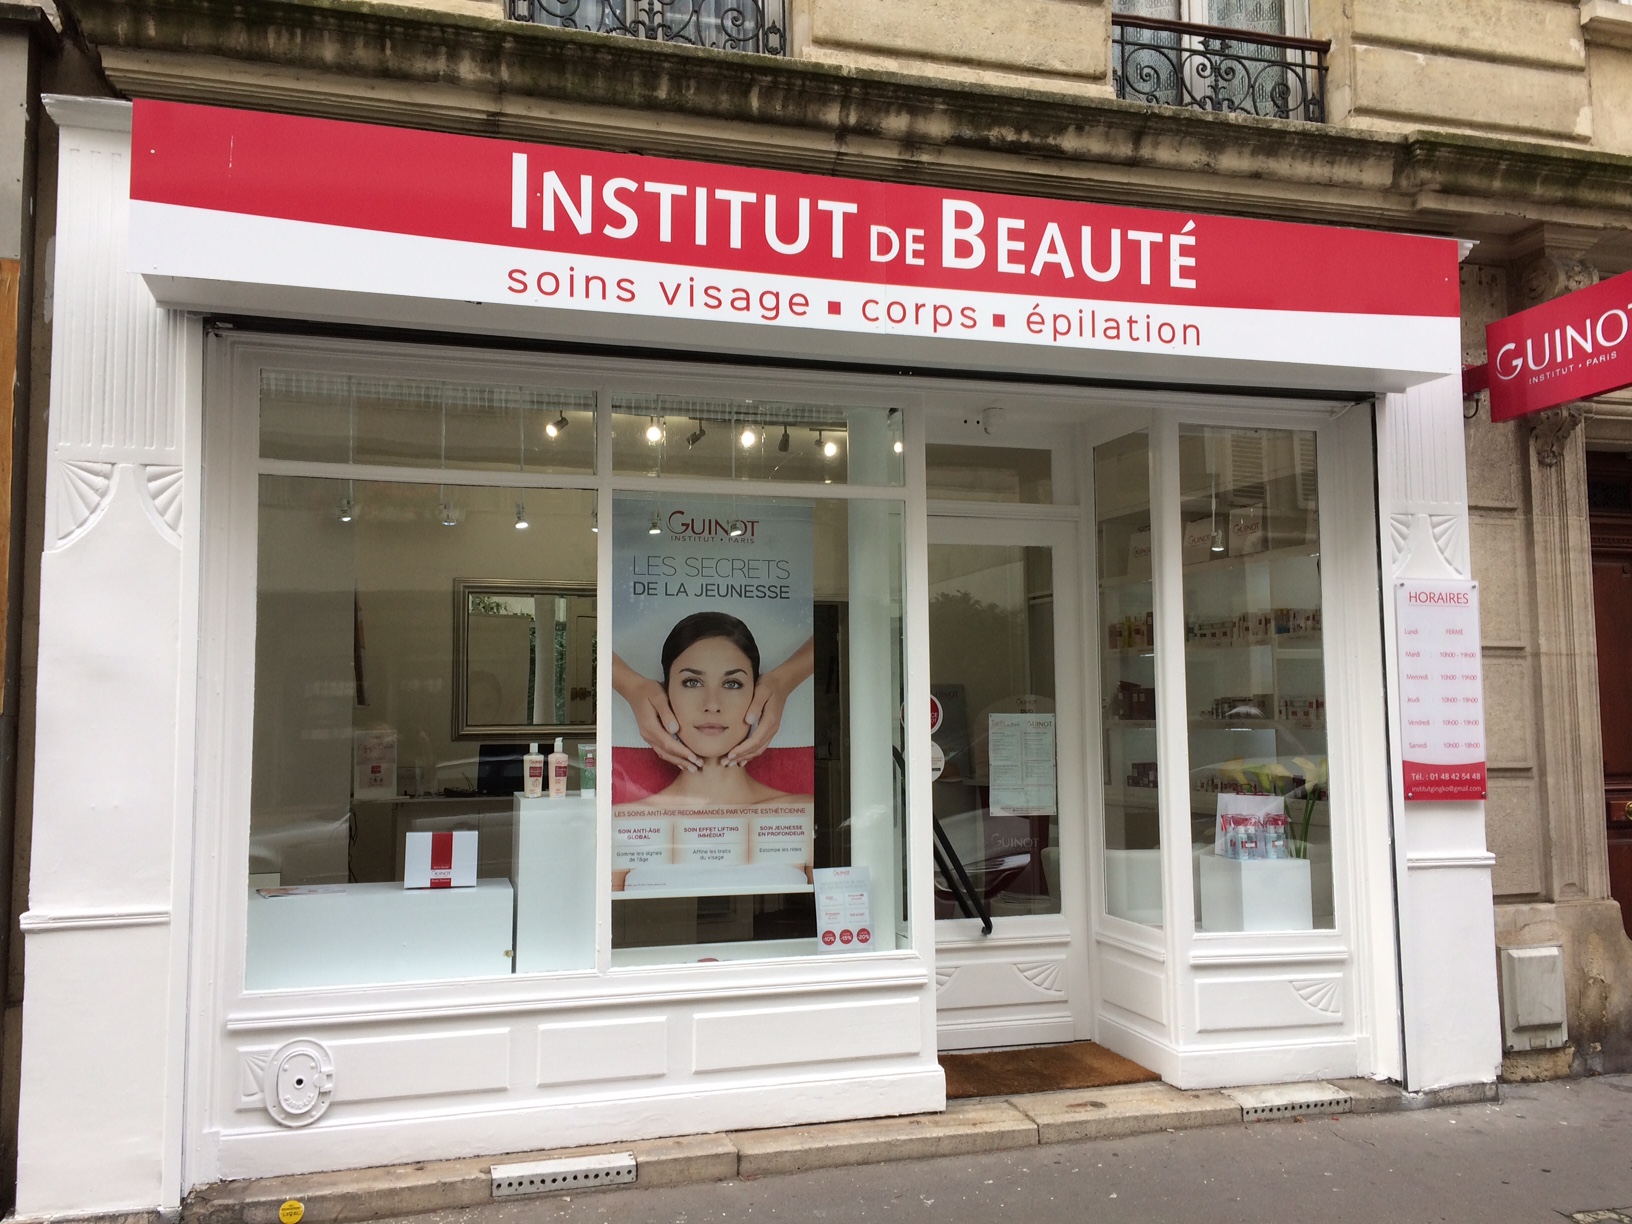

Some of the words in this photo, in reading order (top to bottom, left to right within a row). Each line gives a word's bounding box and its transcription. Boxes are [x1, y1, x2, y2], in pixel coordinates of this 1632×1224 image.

[511, 152, 858, 259] INSTITUT
[870, 224, 925, 266] DE
[942, 198, 1197, 289] BEAUTÉ
[507, 266, 636, 302] soins
[659, 277, 809, 321] visage
[861, 299, 977, 333] corps
[1026, 303, 1201, 346] épilation
[1496, 303, 1632, 380] GUINO
[1528, 364, 1575, 385] INSTITUT
[1586, 351, 1617, 367] PARIS
[670, 535, 715, 543] INSTITUT
[633, 555, 677, 577] LES
[685, 557, 791, 580] SECRETS
[633, 581, 658, 596] DE
[664, 582, 688, 597] LA
[694, 583, 790, 600] JEUNESSE
[1408, 591, 1469, 605] HORAIRES
[1404, 628, 1418, 636] Lundi
[1445, 628, 1464, 636] FERMÉ
[1411, 785, 1482, 793] institutgingko@gmail.com
[677, 808, 725, 816] RECOMMANDÉS
[991, 833, 1040, 849] GUINOT
